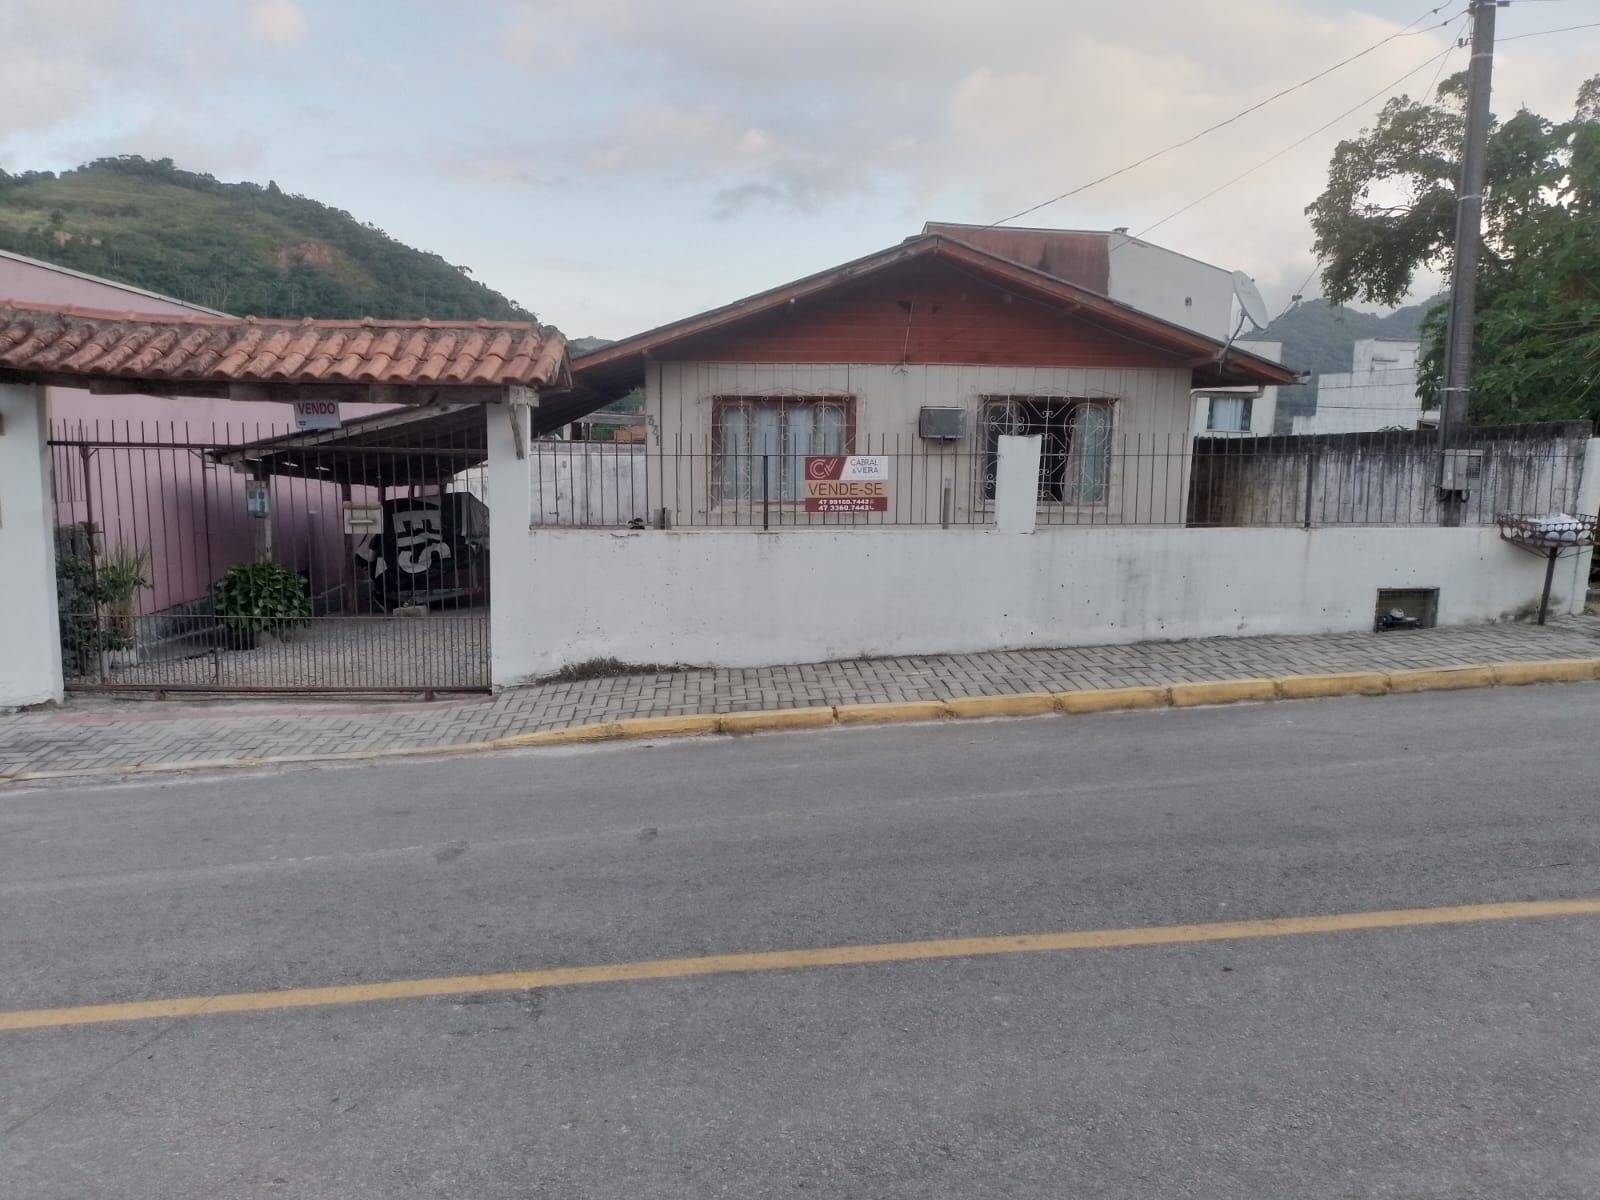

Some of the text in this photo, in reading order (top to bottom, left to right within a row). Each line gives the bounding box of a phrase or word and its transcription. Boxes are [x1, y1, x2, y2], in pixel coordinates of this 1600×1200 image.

[297, 402, 336, 415] VENDO
[850, 458, 879, 466] CABRAL
[808, 482, 884, 496] VENDE-SE
